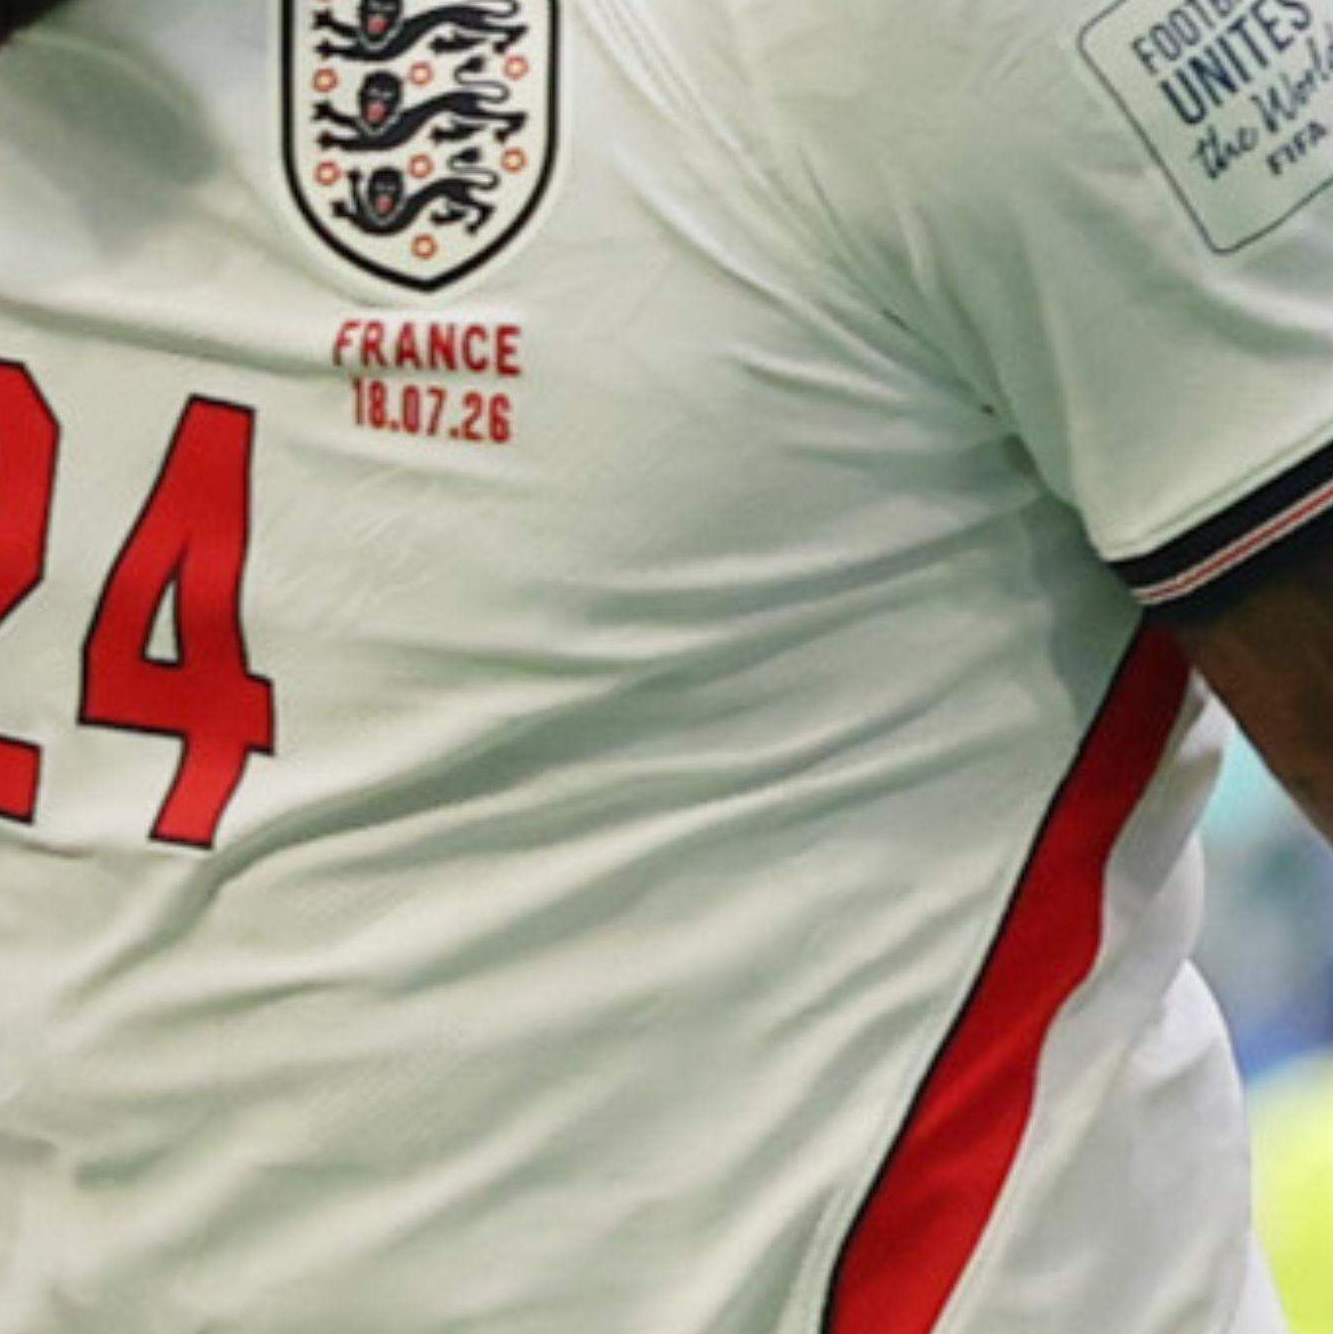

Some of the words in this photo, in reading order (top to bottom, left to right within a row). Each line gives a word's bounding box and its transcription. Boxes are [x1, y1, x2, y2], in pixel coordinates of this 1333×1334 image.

[1190, 124, 1259, 179] the
[1265, 120, 1328, 176] FIFA
[333, 320, 522, 377] FRANCE
[351, 375, 511, 444] 18.07.26
